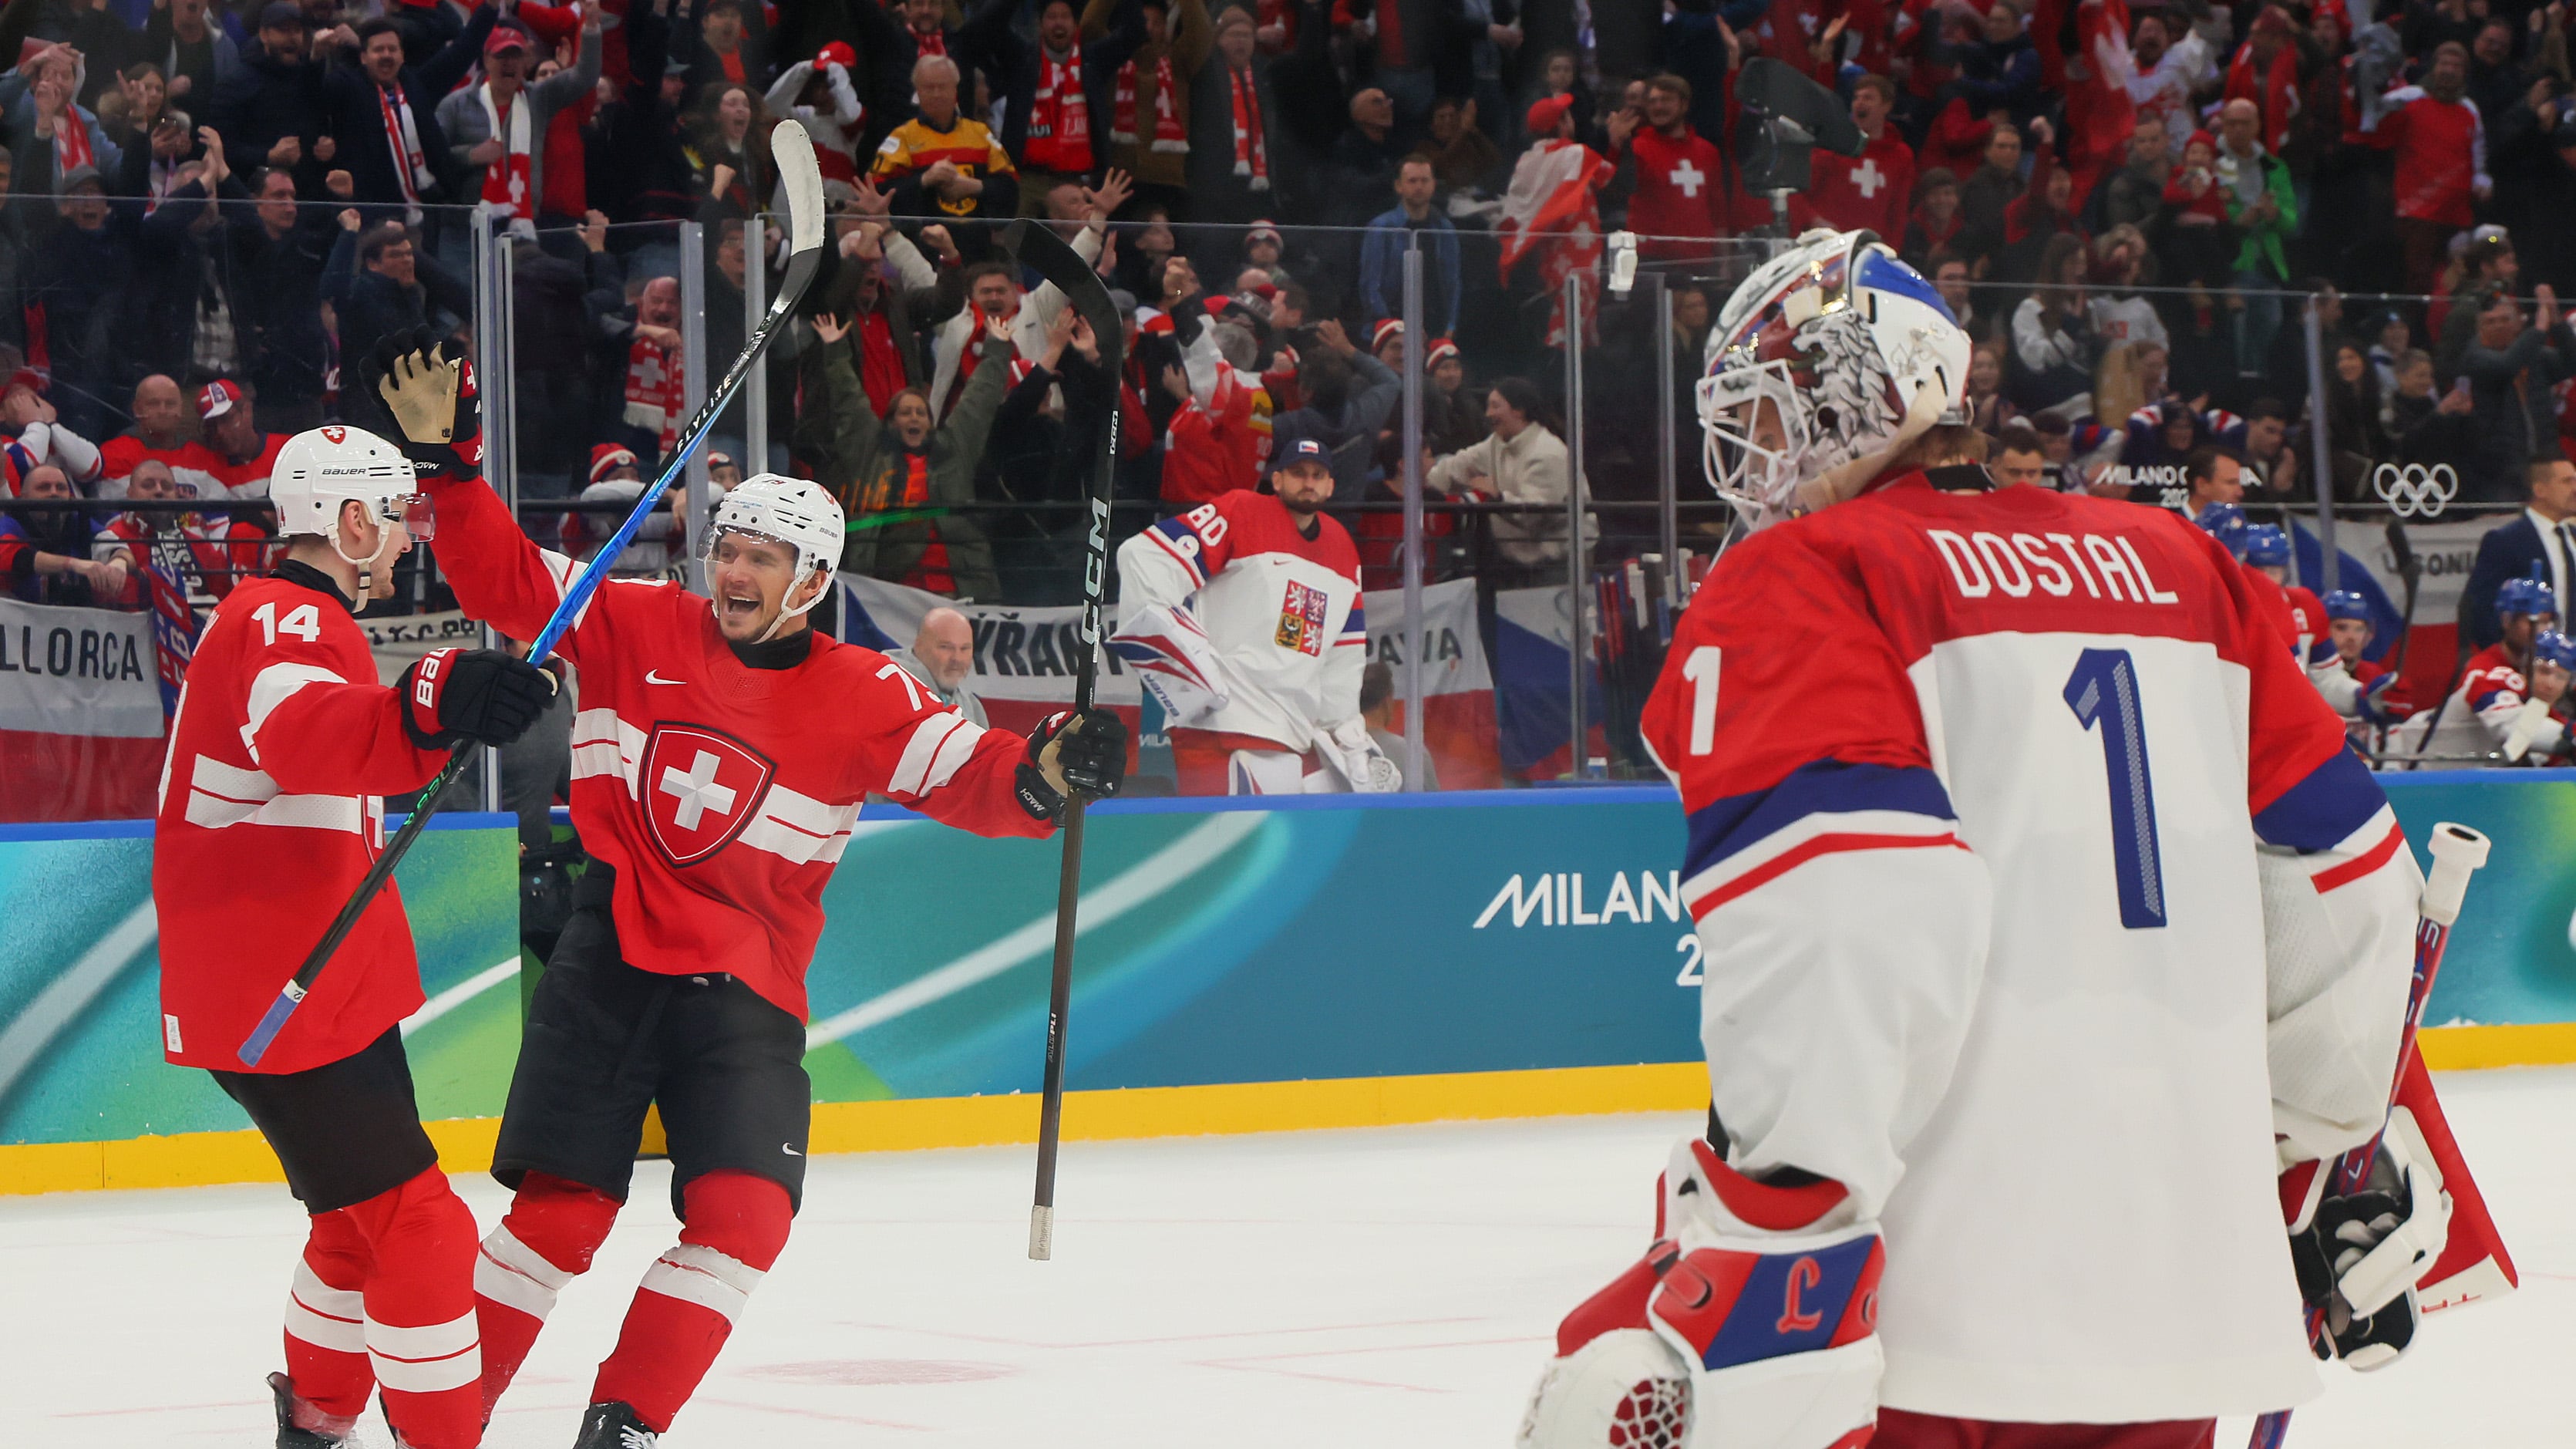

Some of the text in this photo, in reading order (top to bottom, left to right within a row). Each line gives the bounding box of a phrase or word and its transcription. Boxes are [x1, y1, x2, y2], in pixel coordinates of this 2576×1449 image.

[2095, 465, 2177, 486] MILANO
[819, 527, 838, 538] BAUER
[1187, 504, 1228, 547] 80
[1081, 497, 1108, 645] CCM
[1928, 529, 2179, 605] DOSTAL
[251, 602, 320, 646] 14
[0, 625, 143, 682] LLORCA
[1683, 645, 1722, 756] 1
[1019, 787, 1046, 812] MACH
[2063, 648, 2167, 928] 1
[1473, 869, 1690, 929] MILAN
